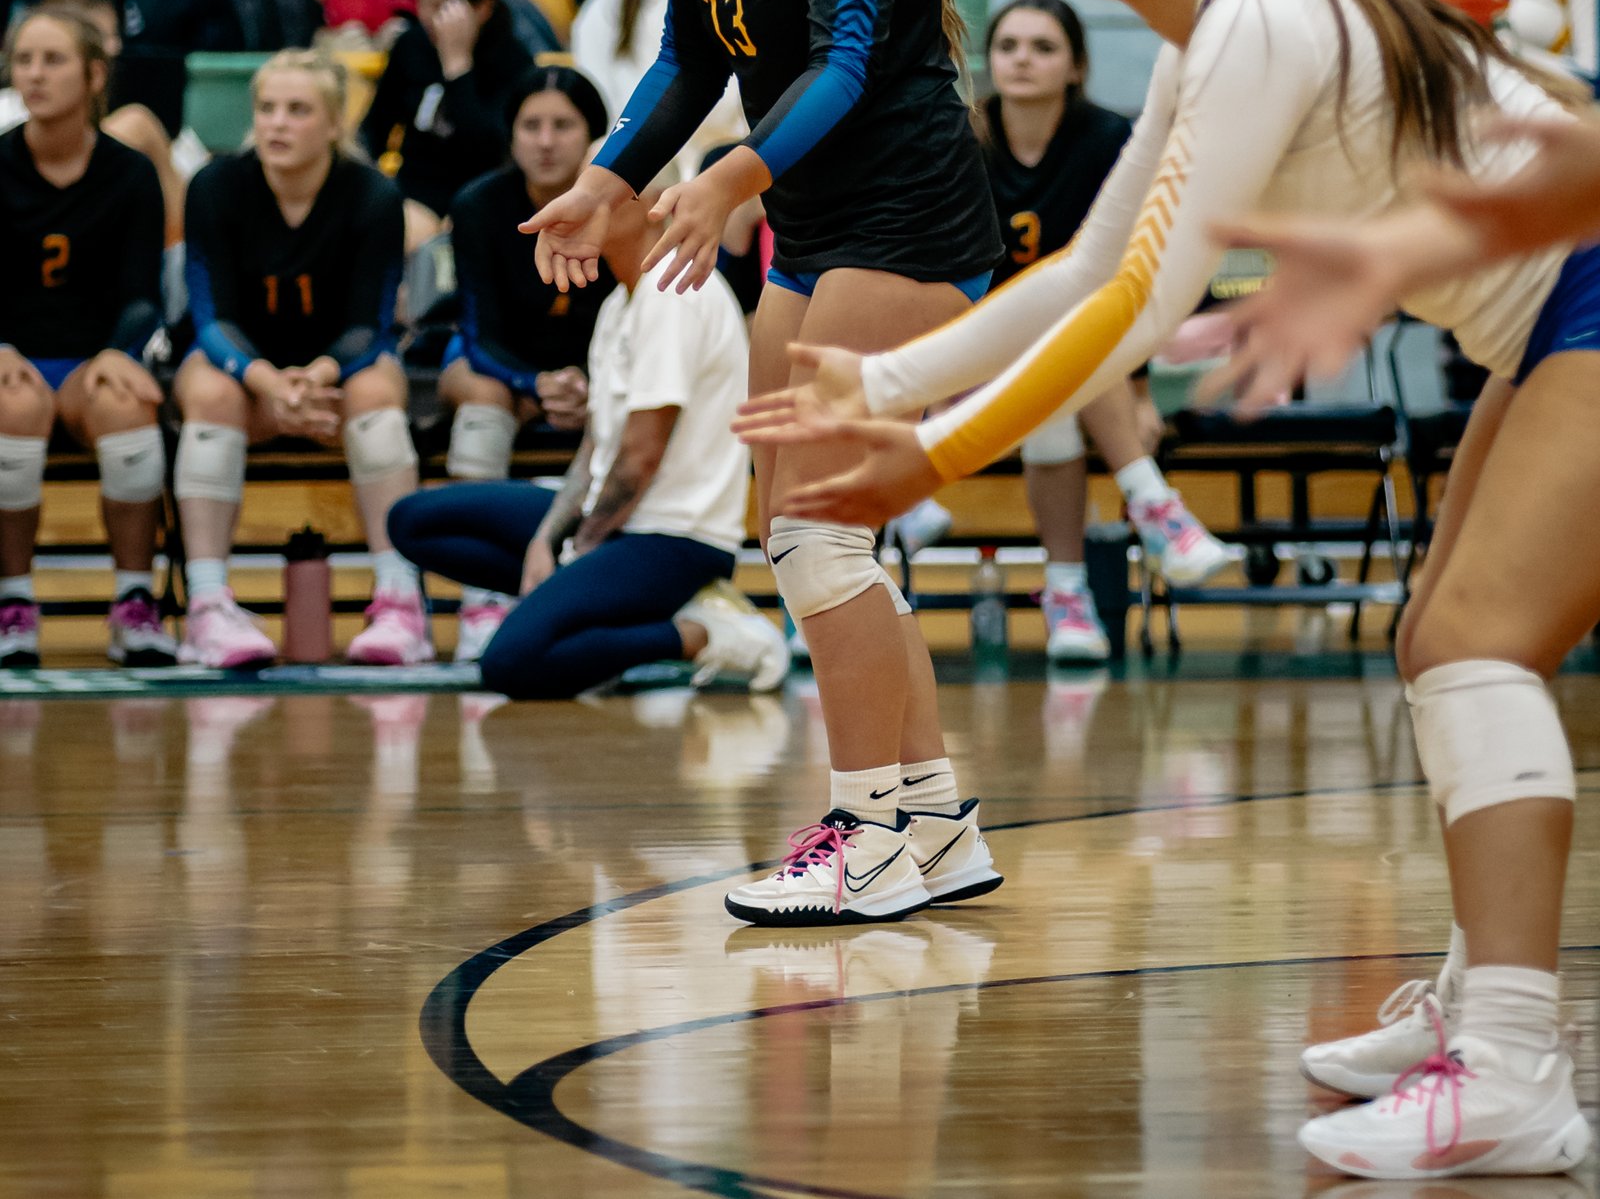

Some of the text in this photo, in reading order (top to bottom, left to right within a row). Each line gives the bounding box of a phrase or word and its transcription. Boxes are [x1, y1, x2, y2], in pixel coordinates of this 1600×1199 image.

[42, 234, 69, 287] 2
[1010, 211, 1041, 263] 3
[263, 274, 313, 315] 11
